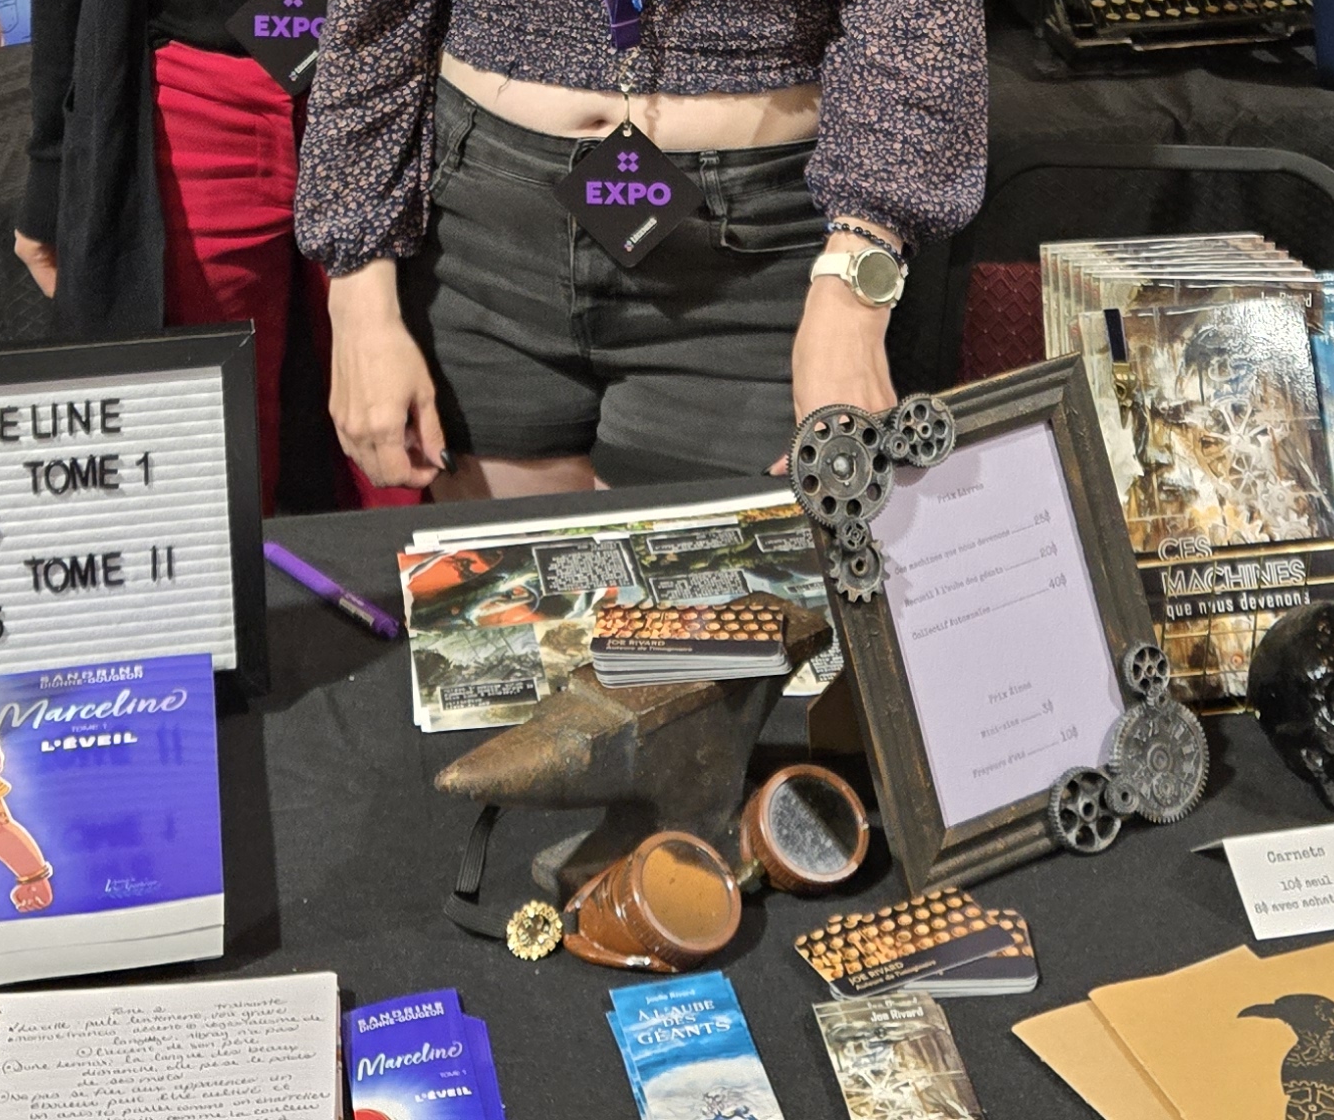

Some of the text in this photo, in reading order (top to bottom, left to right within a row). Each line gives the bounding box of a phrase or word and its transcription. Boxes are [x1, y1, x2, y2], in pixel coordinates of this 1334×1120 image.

[586, 181, 671, 206] EXPO
[25, 452, 152, 496] TOME 1
[938, 483, 984, 504] Prix Livres
[895, 510, 1051, 576] Ces machines que nous devenons 25$
[1158, 535, 1213, 561] CES
[25, 546, 174, 593] TOME II
[904, 590, 934, 608] Recueil
[942, 580, 965, 594] l'aube
[965, 575, 978, 586] des
[979, 566, 1004, 582] géants
[1039, 541, 1058, 558] 20$
[1161, 558, 1307, 597] MACHINES
[912, 572, 1067, 640] Collectif Automnales 40$
[1167, 603, 1193, 620] que
[1240, 592, 1311, 610] devenons
[988, 691, 1008, 704] Prix
[41, 732, 138, 752] L'ÉVEIL
[973, 760, 1007, 778] Frayeurs
[1060, 725, 1078, 742] 10$
[1267, 846, 1325, 864] Carnets
[1281, 875, 1333, 892] 10$ seul
[1254, 901, 1269, 915] 8$
[1271, 901, 1299, 912] avec
[849, 962, 904, 985] JOE RIVARD
[654, 1000, 715, 1019] L'AUBE
[662, 1014, 696, 1027] DES
[871, 1007, 924, 1023] Joe Rivard
[637, 1019, 733, 1045] GÉANTS
[357, 1041, 463, 1082] Marceline
[415, 1086, 472, 1102] L'ÉVEIL
